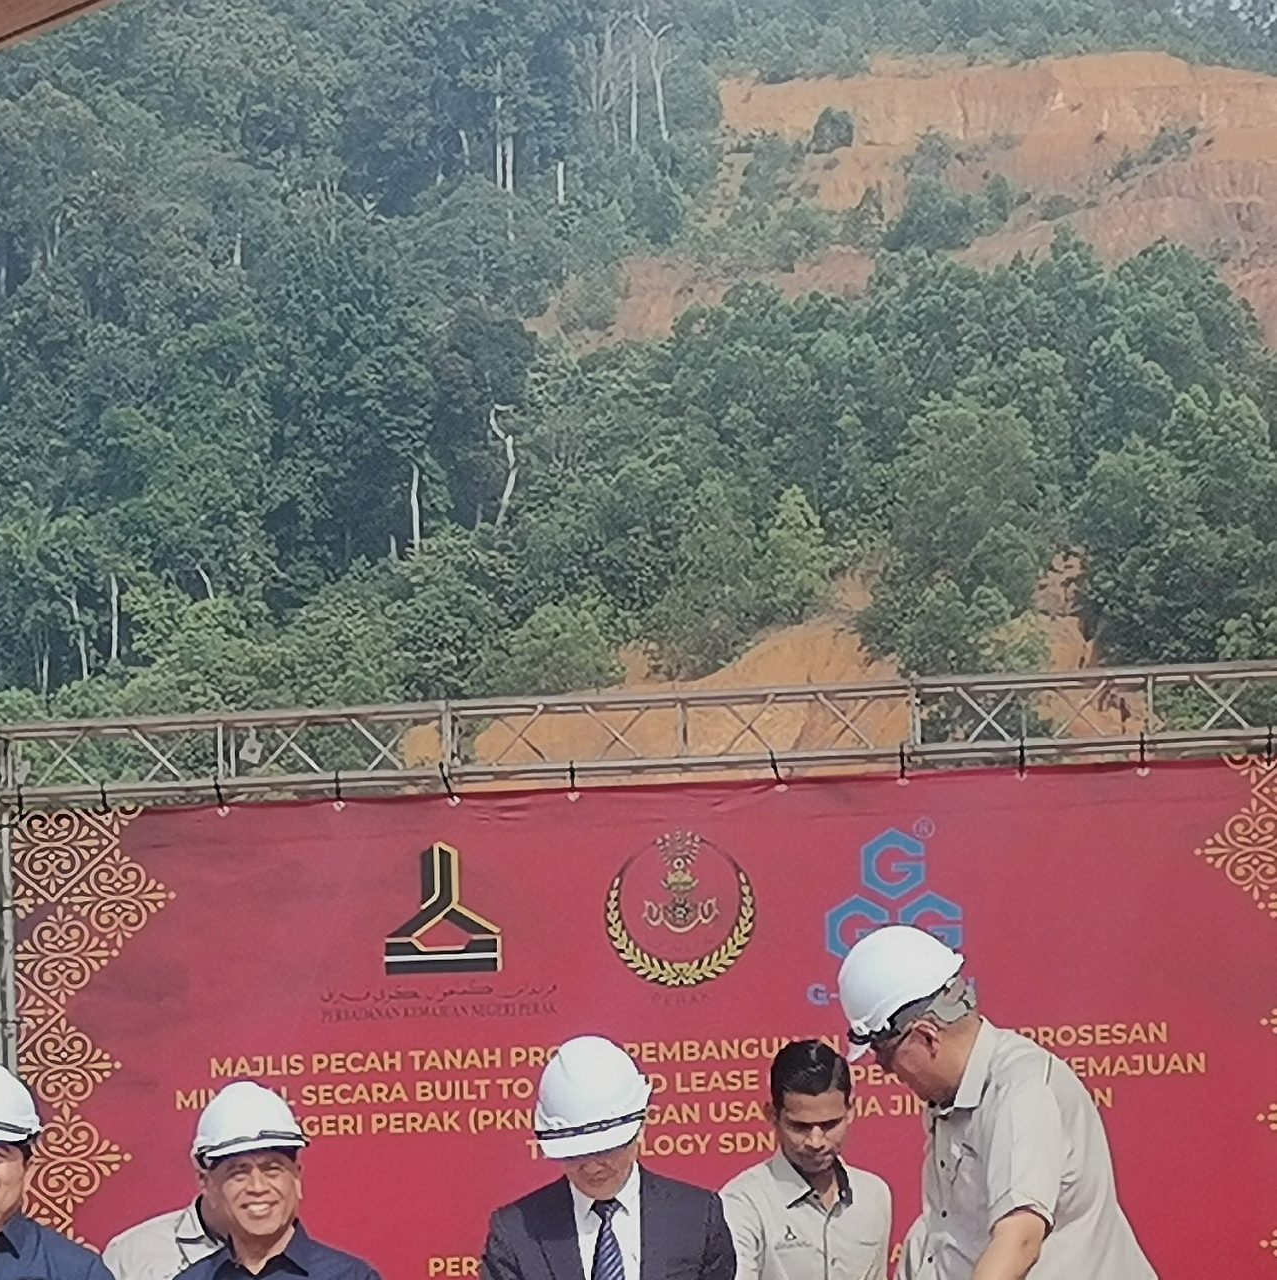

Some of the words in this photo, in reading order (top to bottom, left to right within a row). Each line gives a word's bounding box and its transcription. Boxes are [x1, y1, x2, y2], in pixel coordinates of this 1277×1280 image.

[209, 1053, 305, 1078] MAJLIS
[311, 1051, 402, 1075] PECAH
[408, 1047, 502, 1072] TANAH
[300, 1081, 409, 1106] SECARA
[414, 1079, 491, 1103] BUILT
[496, 1077, 534, 1100] TO
[675, 1069, 760, 1094] LEASE
[1066, 1052, 1207, 1078] EMAJUAN
[297, 1114, 363, 1137] GERI
[371, 1110, 461, 1135] PERAK
[468, 1107, 533, 1135] (PKN
[708, 1100, 766, 1124] USA
[718, 1130, 776, 1155] SDN
